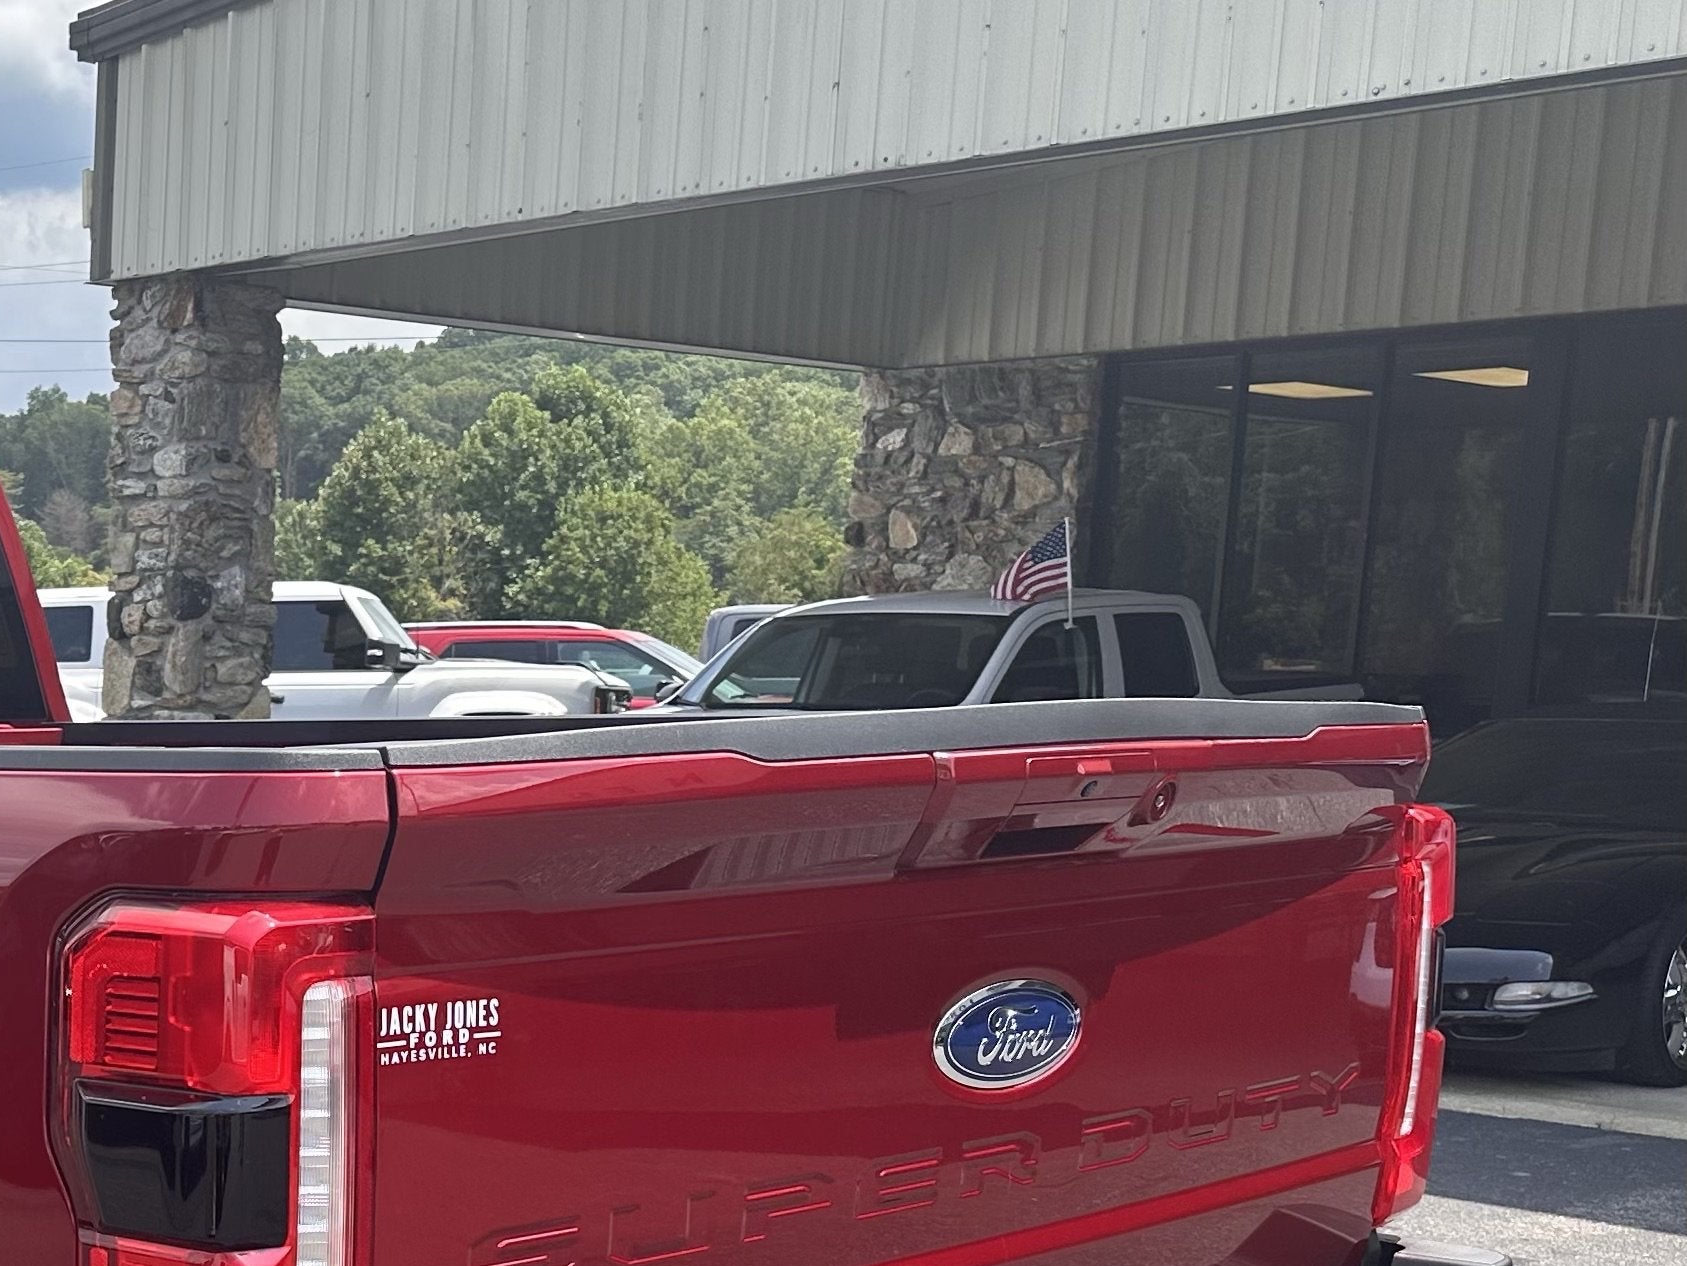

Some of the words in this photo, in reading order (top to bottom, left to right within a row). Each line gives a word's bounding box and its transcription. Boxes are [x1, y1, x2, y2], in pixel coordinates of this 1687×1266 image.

[379, 1003, 438, 1037] JACKY
[445, 998, 500, 1030] JONES
[977, 1004, 1056, 1066] Ford
[380, 1044, 473, 1066] HAYESVILLE,
[478, 1041, 497, 1056] NC
[409, 1028, 470, 1049] FORD
[1078, 1062, 1361, 1172] DUTY
